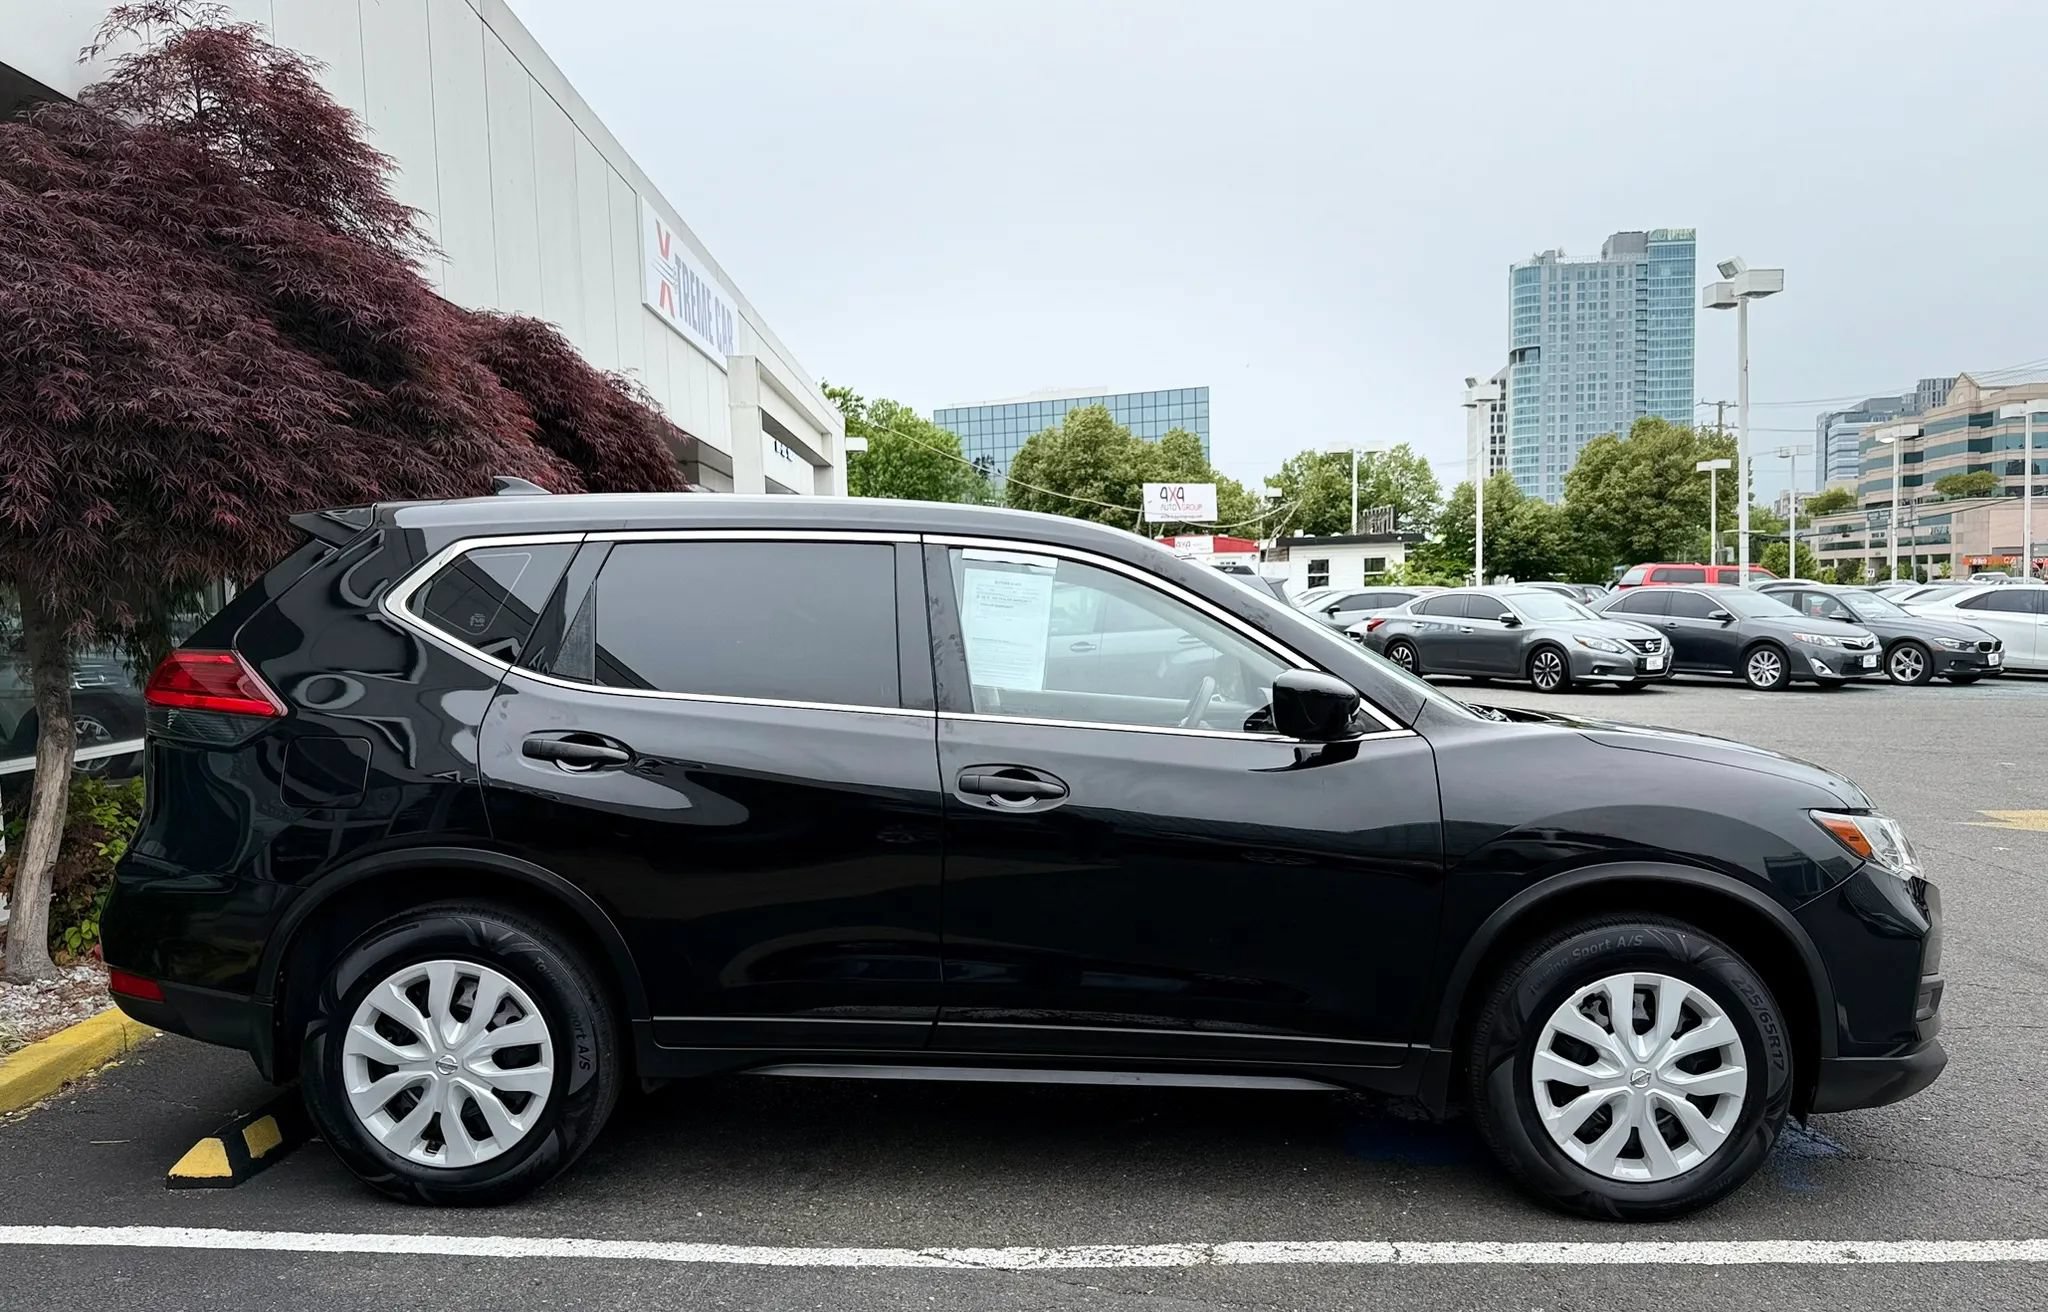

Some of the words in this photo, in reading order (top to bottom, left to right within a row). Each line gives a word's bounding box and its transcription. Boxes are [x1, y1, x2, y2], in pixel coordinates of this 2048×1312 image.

[714, 282, 734, 357] CAR
[1160, 503, 1177, 511] AUTO
[1181, 503, 1203, 511] GROUP
[1571, 937, 1612, 961] Sport
[1616, 934, 1645, 948] A/S
[1730, 975, 1786, 1072] 225/65R17
[578, 1044, 591, 1071] A/S
